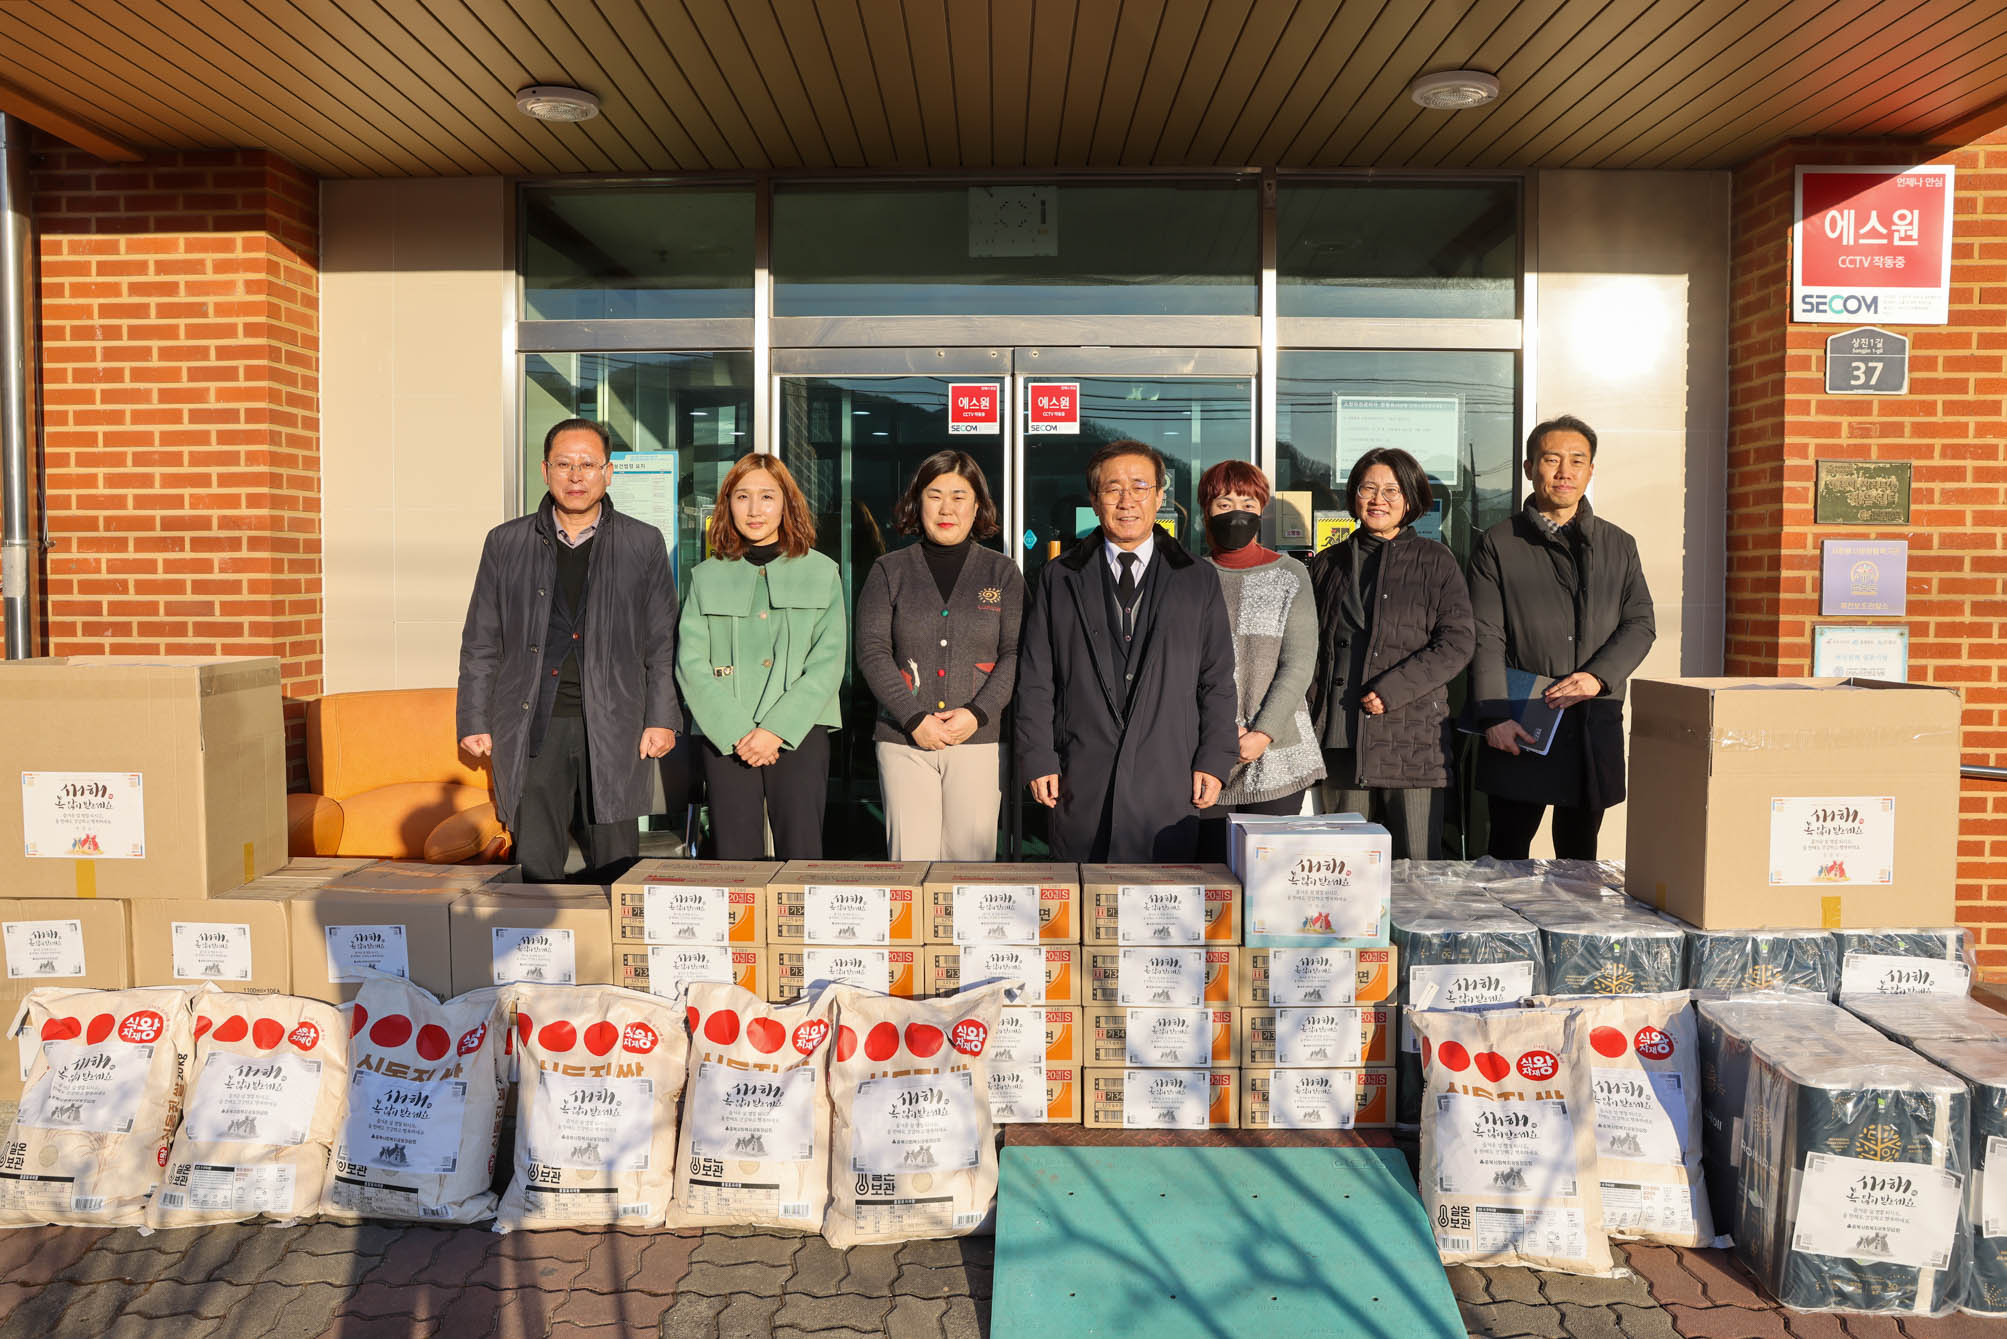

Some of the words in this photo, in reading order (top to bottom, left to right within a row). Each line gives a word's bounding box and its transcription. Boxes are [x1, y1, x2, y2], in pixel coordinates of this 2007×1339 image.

[1896, 177, 1922, 188] 언제나
[1925, 177, 1943, 188] 안심
[1824, 208, 1919, 246] 에스원
[1838, 256, 1871, 268] CCTV
[1872, 256, 1906, 268] 작동중
[1802, 294, 1879, 315] SECOM
[1850, 362, 1884, 385] 37
[958, 396, 990, 410] 에스원
[1037, 396, 1070, 410] 에스원
[951, 424, 978, 432] SECOM
[1030, 424, 1058, 432] SECOM
[747, 894, 753, 903] S
[904, 890, 911, 900] S
[1062, 890, 1068, 900] S
[1224, 890, 1230, 900] S
[748, 954, 755, 963] S
[906, 952, 912, 962] S
[1062, 951, 1069, 960] S
[1222, 952, 1228, 962] S
[1380, 952, 1388, 962] S
[1065, 1012, 1071, 1022] S
[1224, 1012, 1230, 1022] S
[1379, 1012, 1385, 1022] S
[1064, 1070, 1070, 1080] S
[1222, 1076, 1230, 1084] S
[1379, 1075, 1385, 1084] S
[10, 1141, 27, 1156] 실온
[5, 1156, 25, 1171] 보관
[540, 1168, 562, 1184] 보관
[702, 1164, 724, 1178] 보관
[871, 1182, 896, 1197] 보관
[1450, 1205, 1470, 1218] 실온
[1450, 1218, 1471, 1230] 보관
